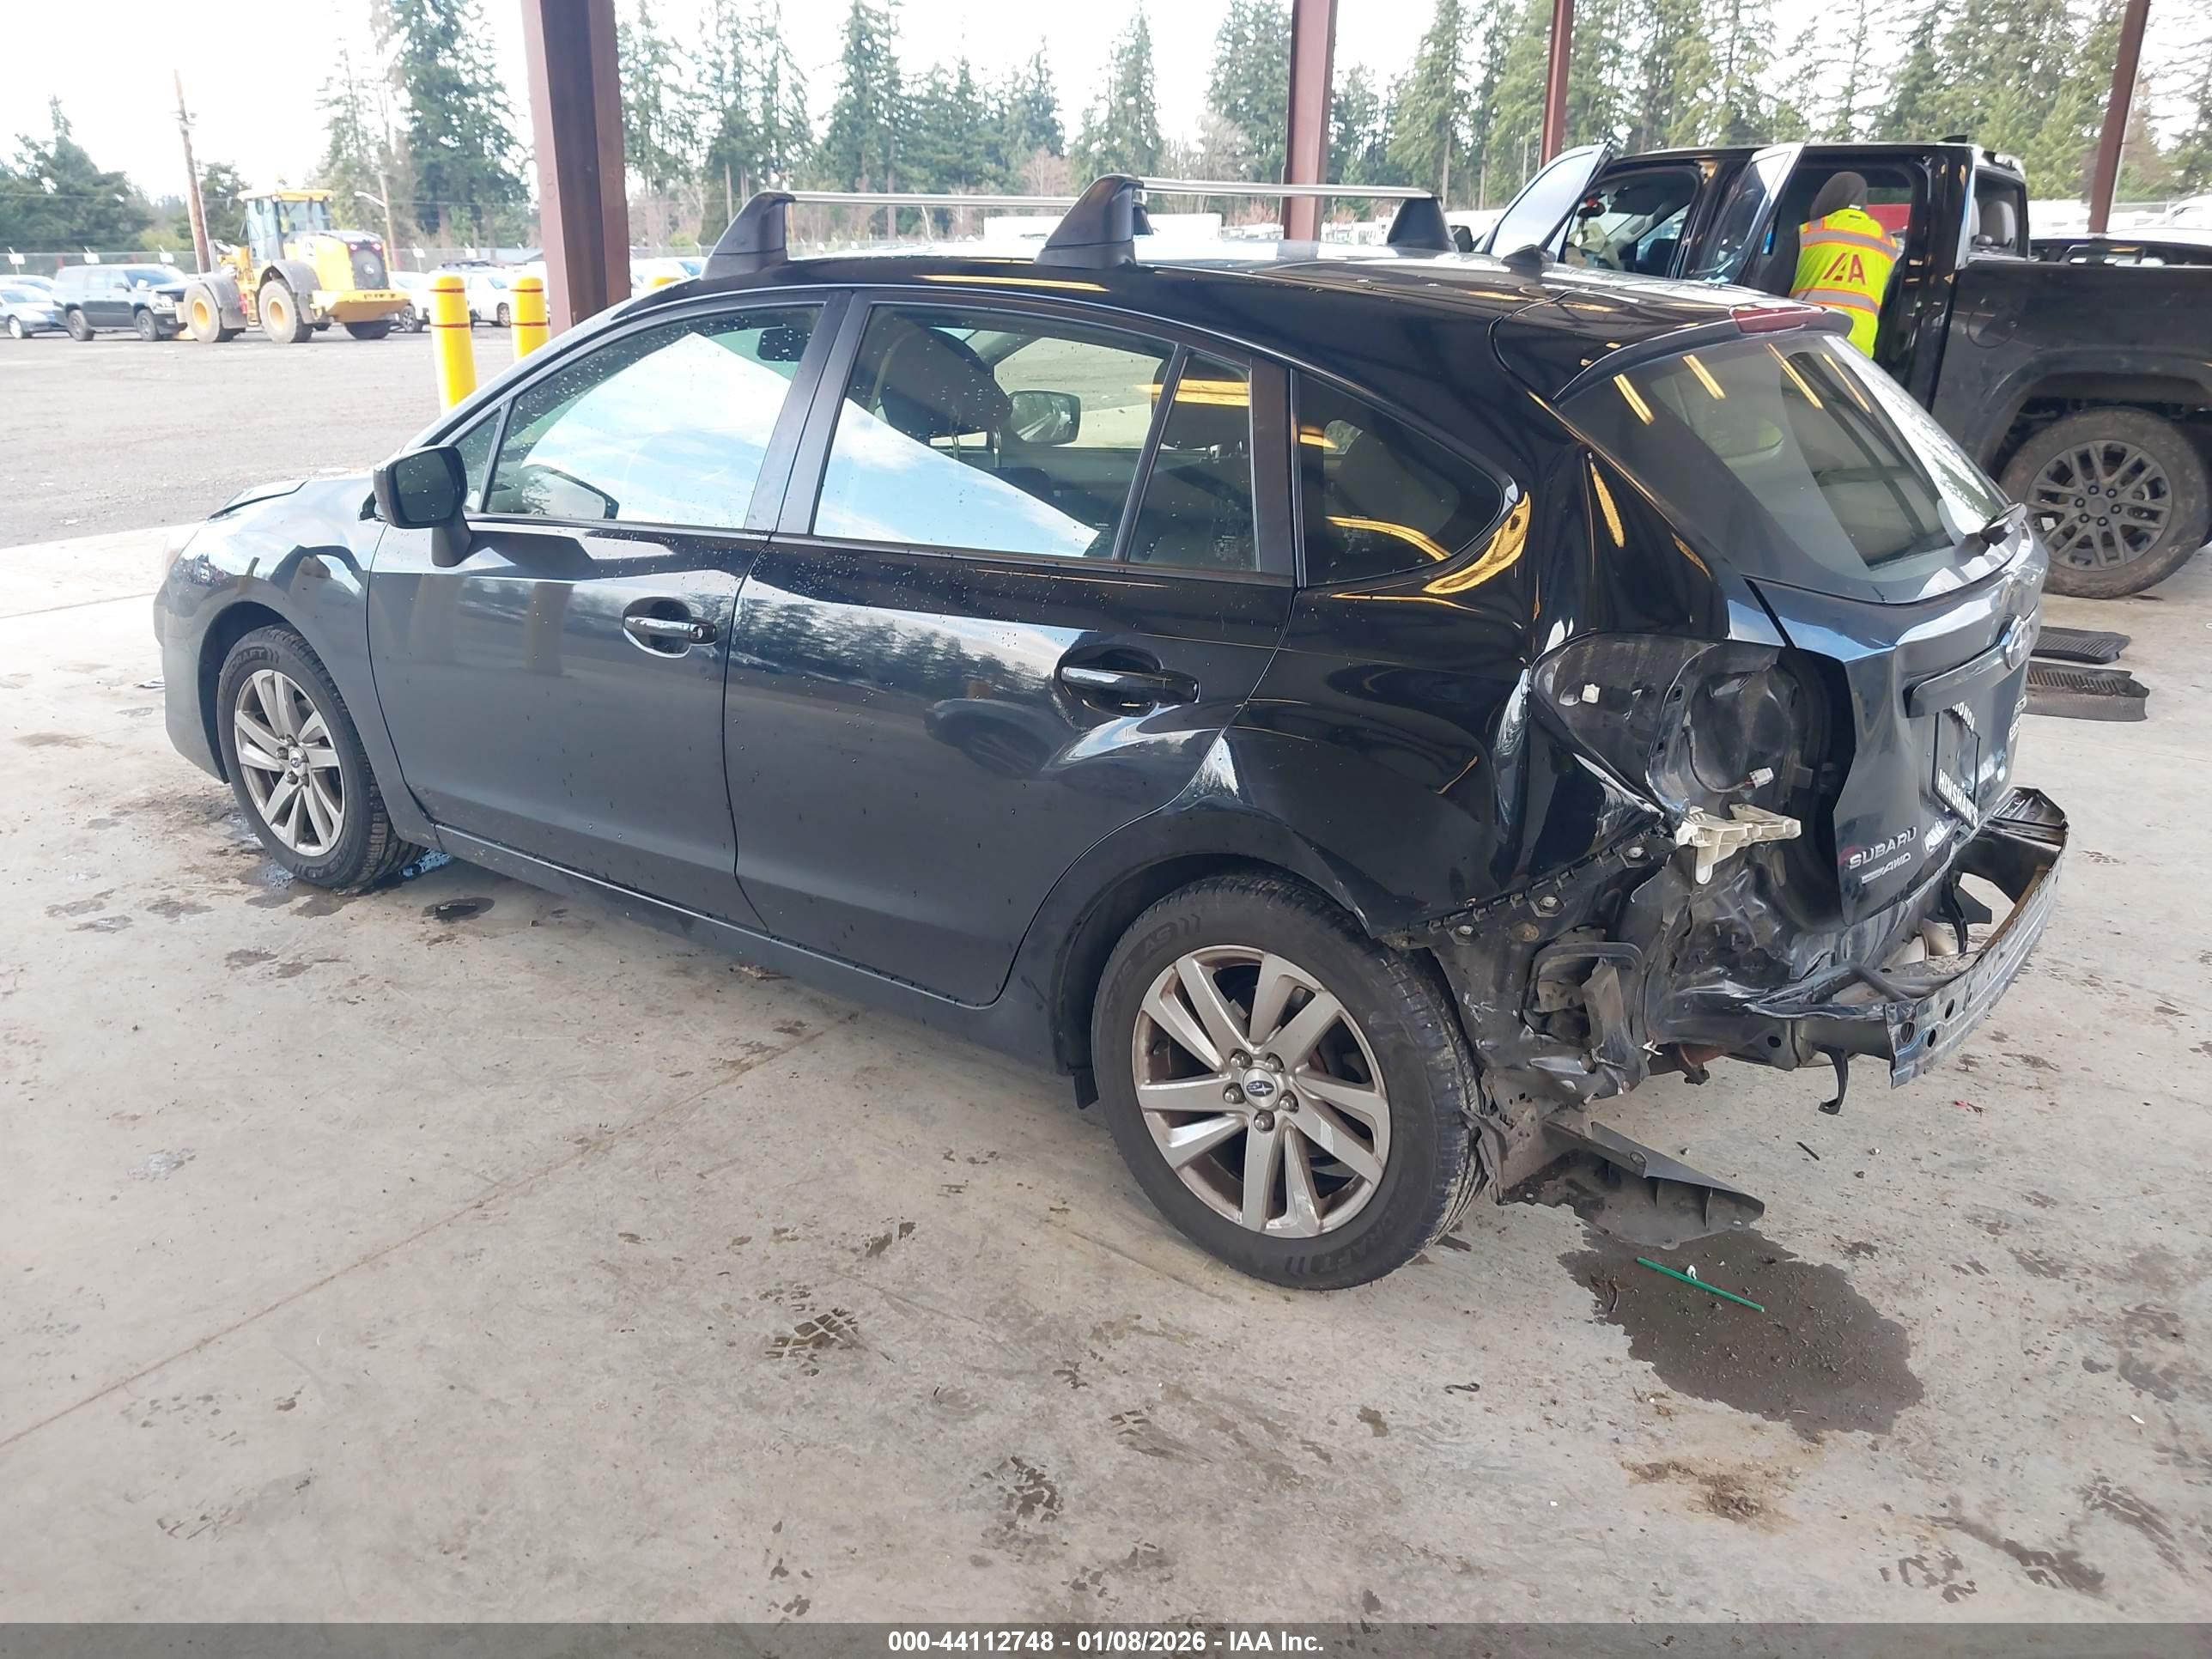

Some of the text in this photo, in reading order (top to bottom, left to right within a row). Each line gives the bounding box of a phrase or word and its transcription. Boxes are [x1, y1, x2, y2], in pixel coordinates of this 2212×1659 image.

[1937, 769, 1979, 829] HINSHAW'S
[1849, 826, 1916, 870] SUBARU
[1882, 853, 1911, 876] AWD
